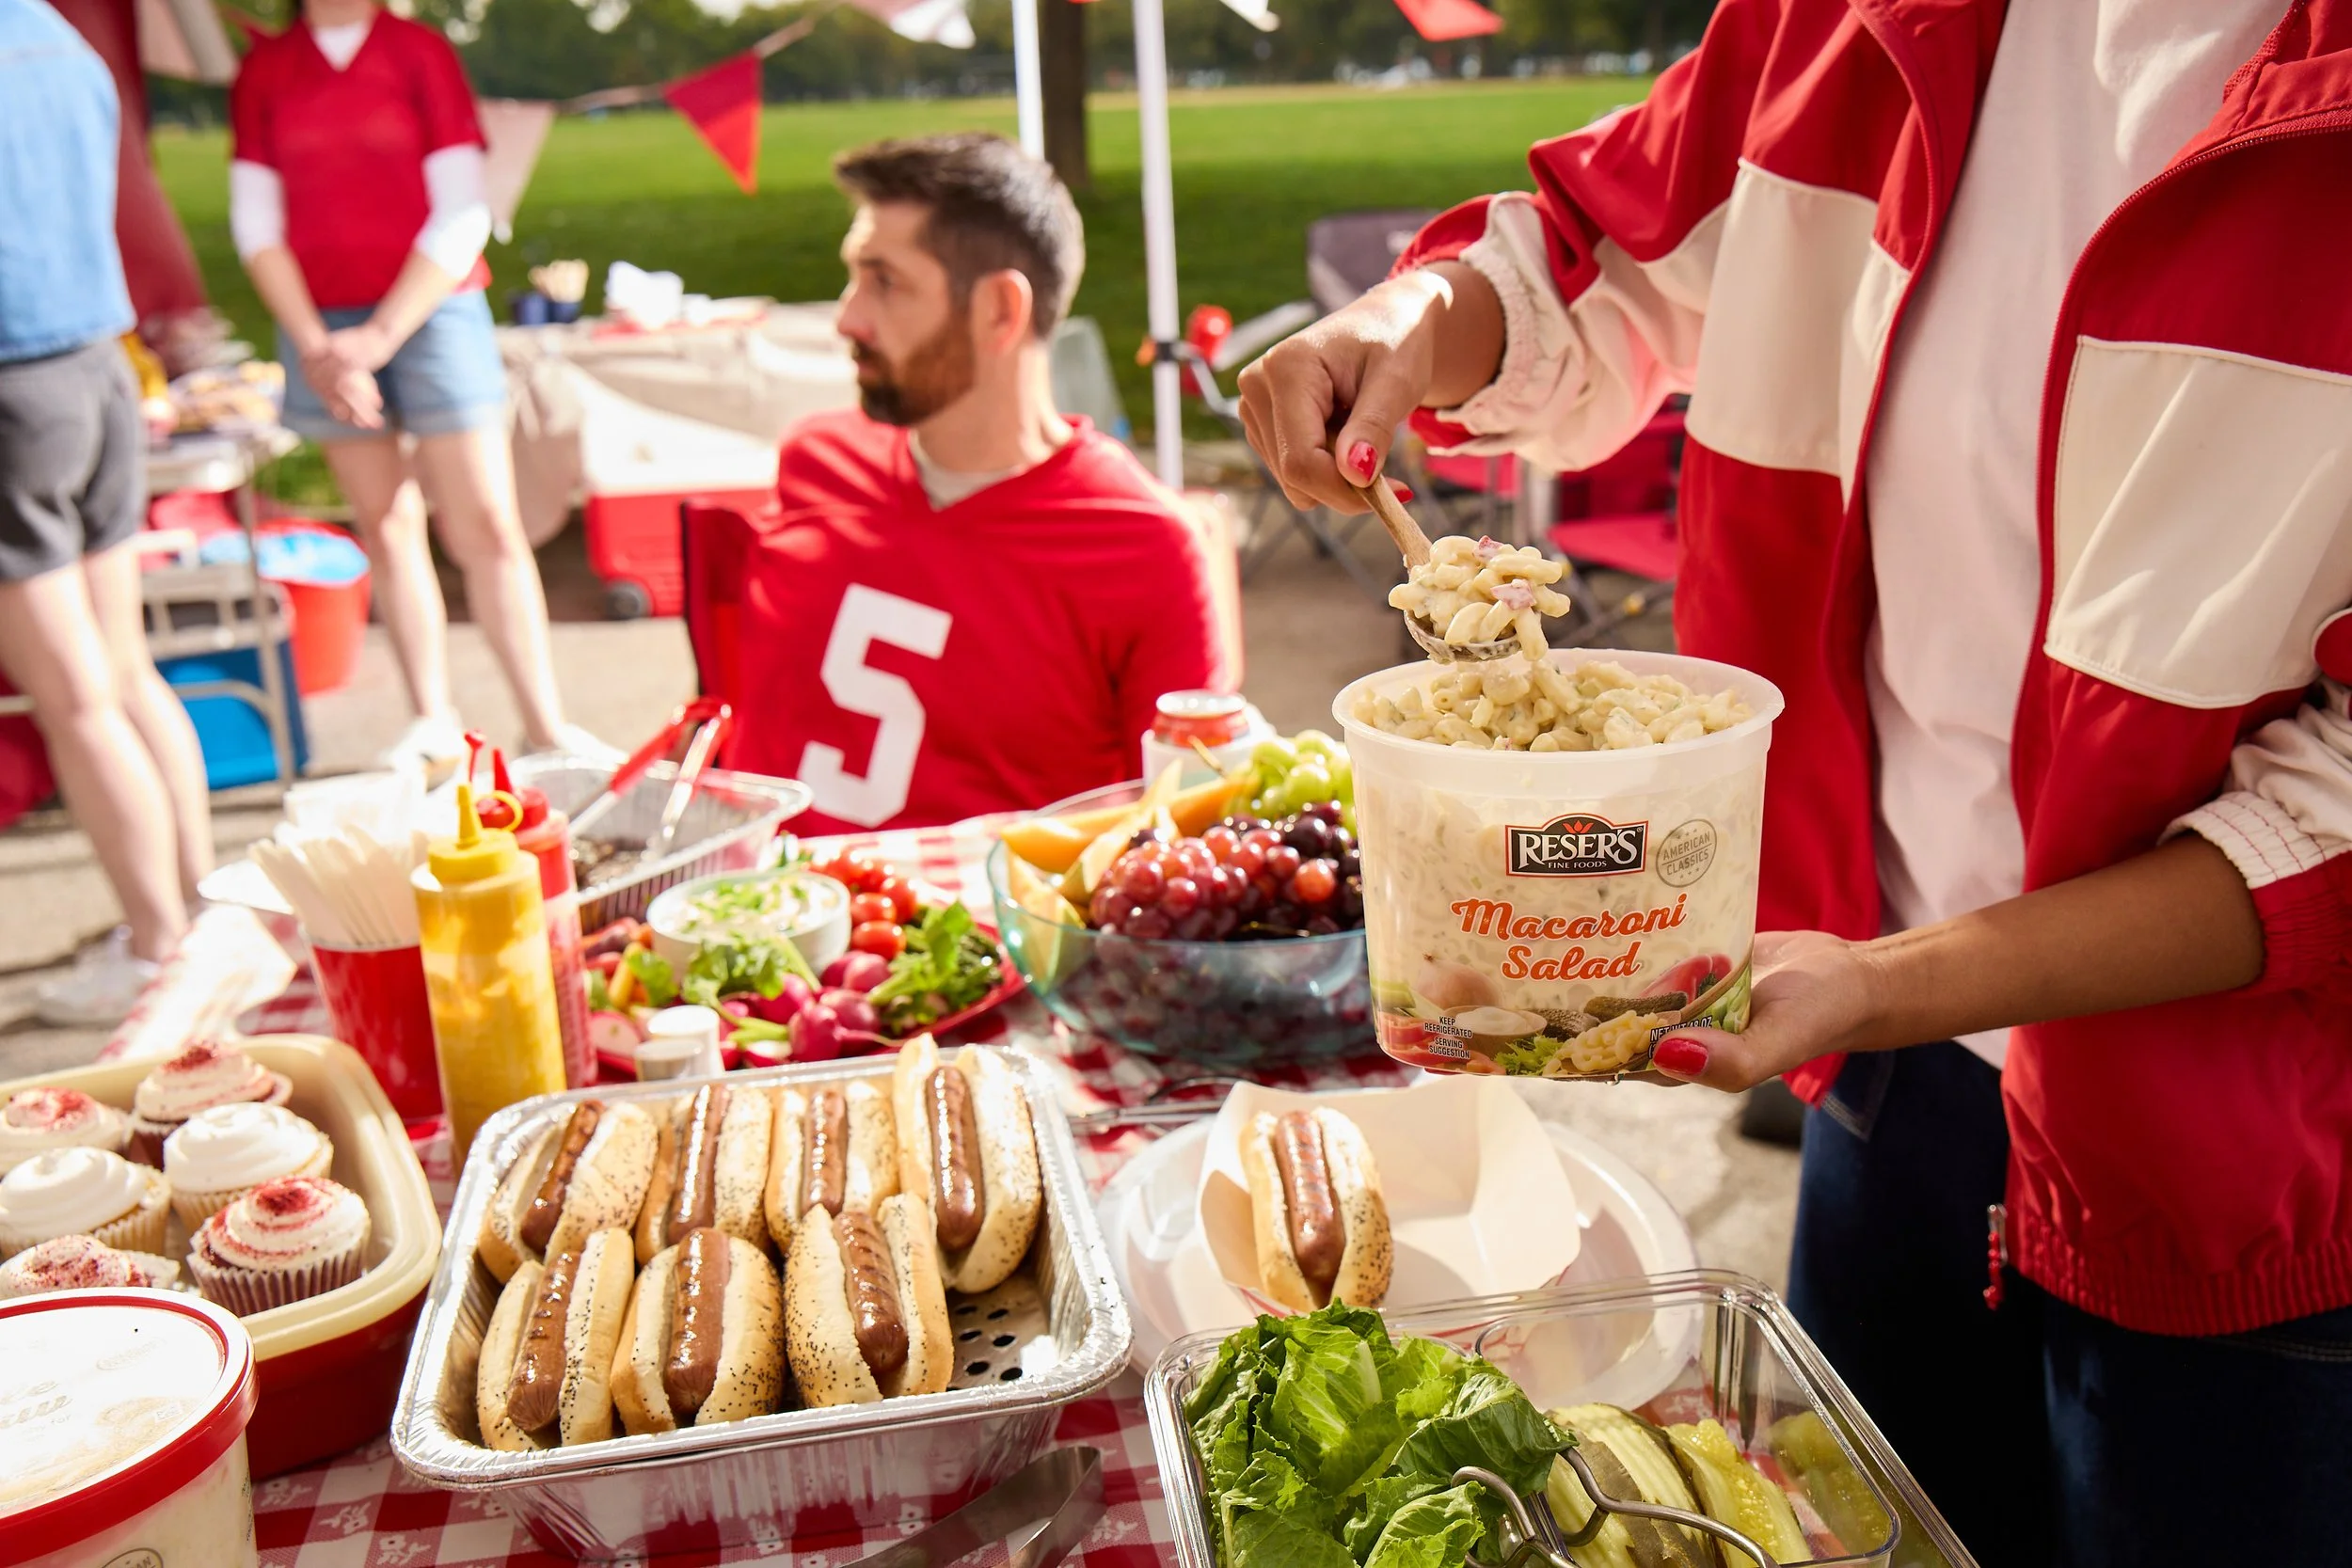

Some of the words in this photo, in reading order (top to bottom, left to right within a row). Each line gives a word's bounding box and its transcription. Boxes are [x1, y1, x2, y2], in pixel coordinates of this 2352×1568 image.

[796, 582, 954, 829] 5
[1518, 830, 1638, 869] RESER'S
[1662, 831, 1710, 861] AMERICAN
[1574, 861, 1607, 869] FOODS
[1666, 848, 1709, 876] CLASSICS
[1451, 893, 1688, 941] Macaroni
[1502, 941, 1642, 980] Salad
[1424, 1022, 1472, 1037] REFRIGERATED
[1438, 1016, 1456, 1025] KEEP
[1429, 1046, 1470, 1059] SUGGESTION
[1435, 1037, 1463, 1049] SERVING
